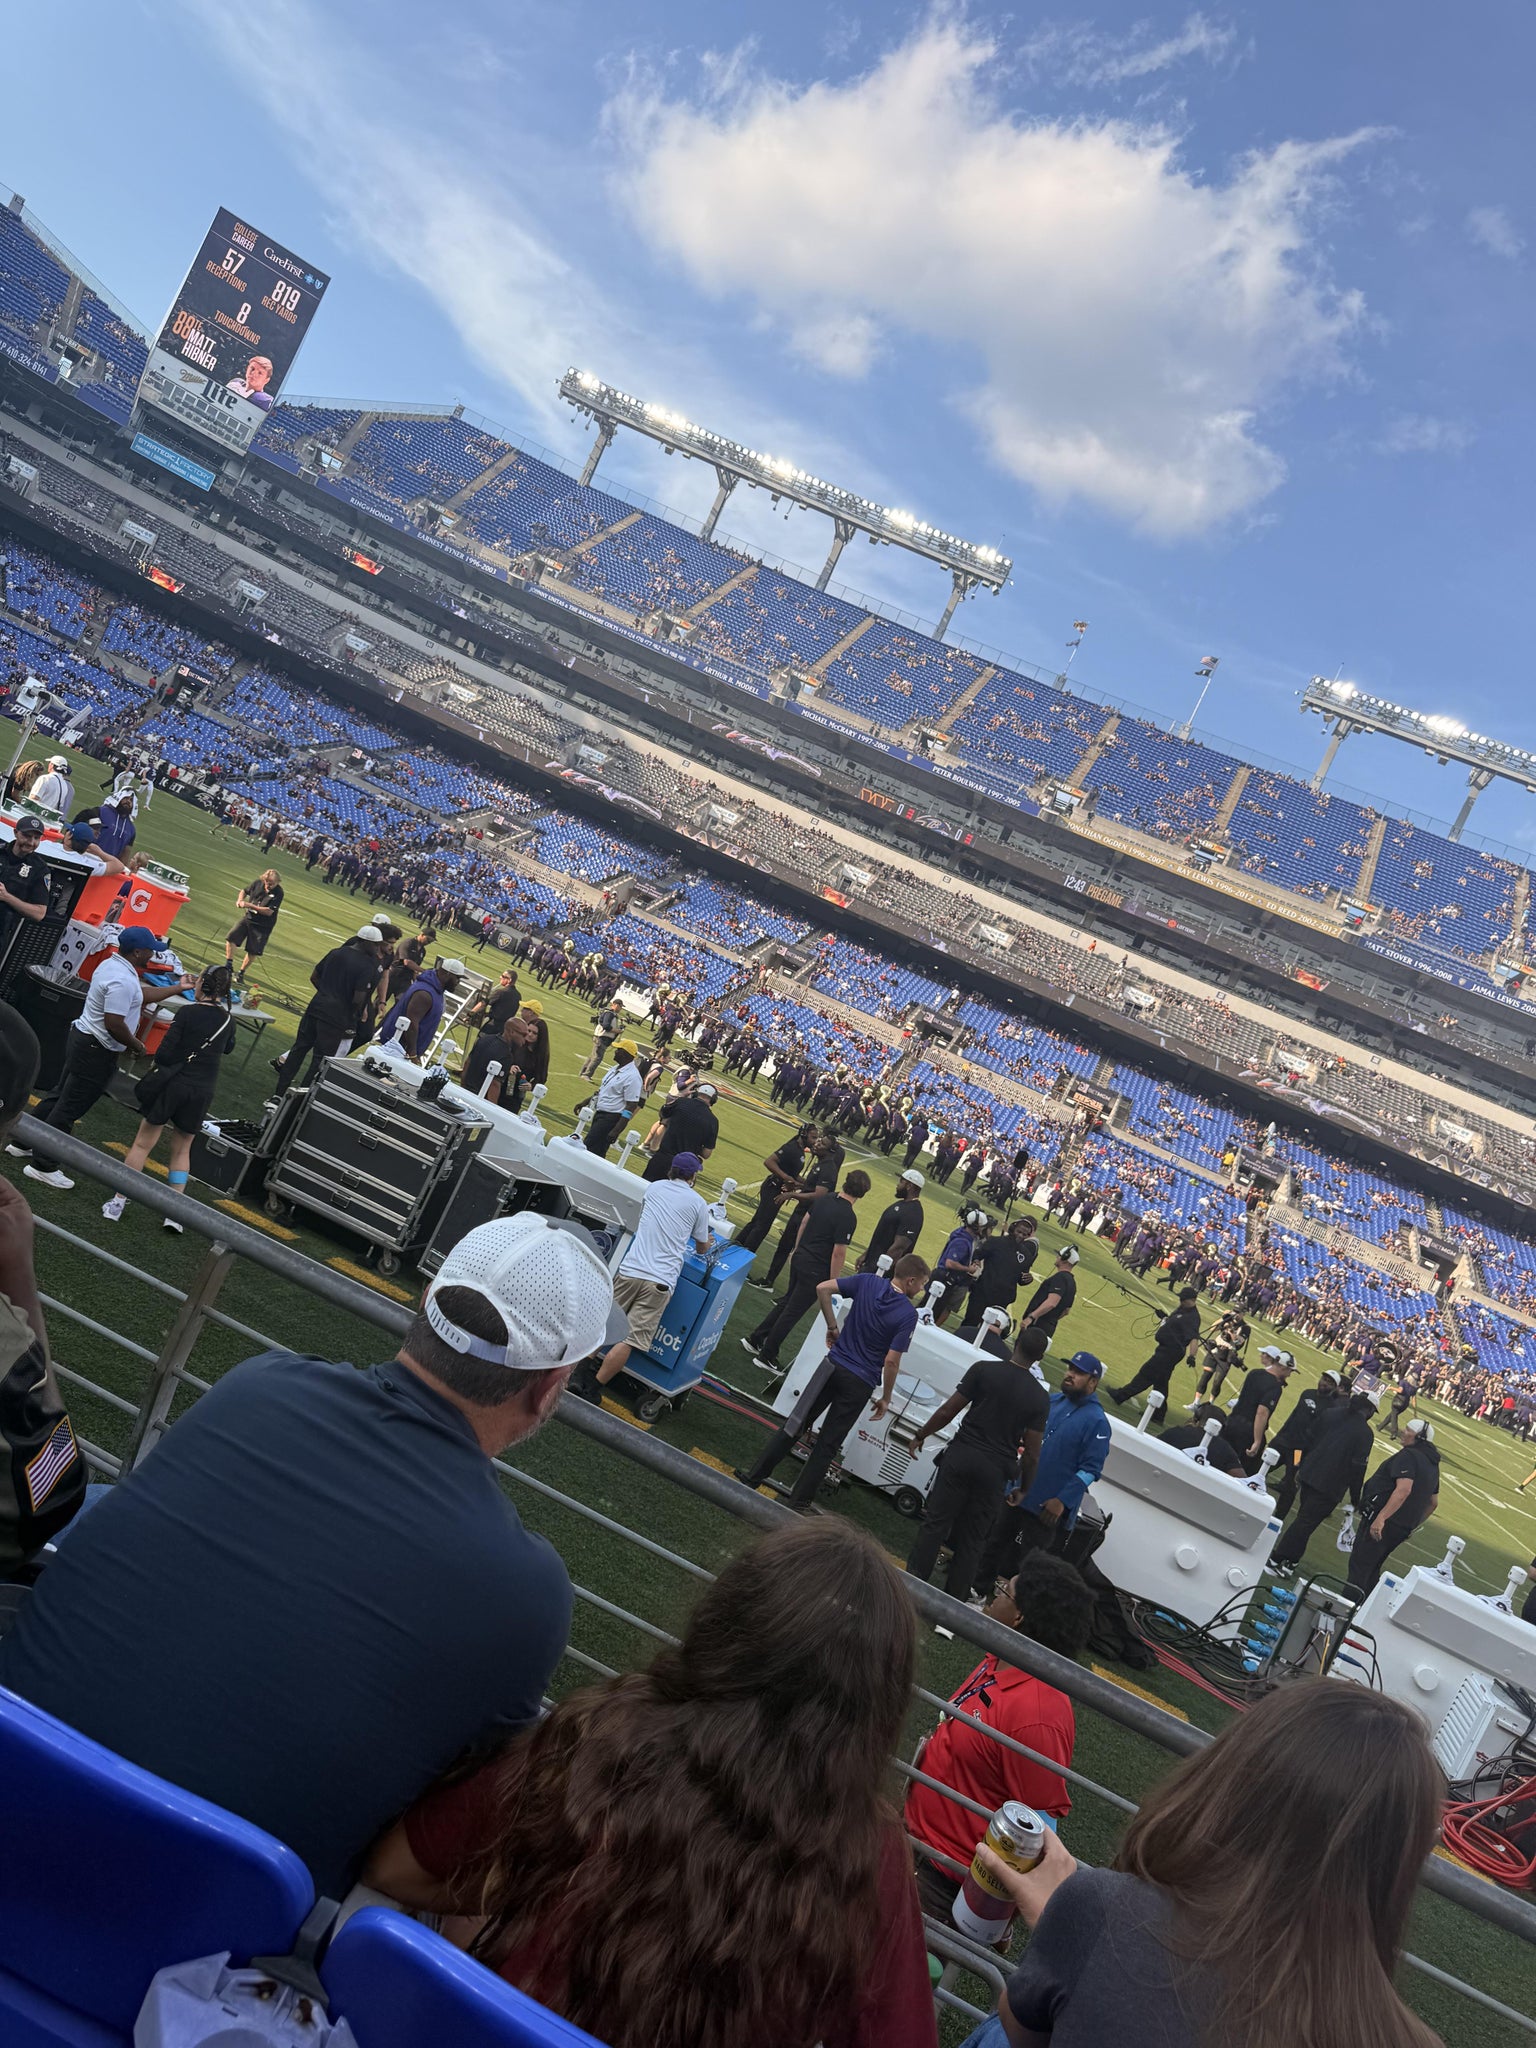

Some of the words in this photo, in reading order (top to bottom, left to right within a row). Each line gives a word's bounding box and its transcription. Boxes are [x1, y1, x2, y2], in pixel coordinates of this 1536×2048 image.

[231, 232, 254, 251] CAREER
[234, 222, 258, 244] COLLEGE
[206, 260, 248, 292] RECEPTIONS
[222, 248, 246, 275] 57
[264, 247, 304, 280] CareFirst
[261, 296, 276, 312] REC
[275, 302, 298, 324] YARDS
[271, 280, 301, 311] 819
[172, 311, 194, 340] 88
[215, 309, 261, 345] TOUCHDOWNS
[237, 302, 252, 325] 8
[188, 328, 217, 354] MATT
[4, 346, 48, 375] 410-324-6141
[181, 343, 217, 372] HIBNER
[180, 368, 207, 385] Miller
[201, 380, 238, 410] Lite
[137, 436, 176, 461] STRATEGIC
[179, 460, 210, 480] FACTORY
[348, 496, 367, 509] RING
[368, 506, 395, 524] HONOR
[416, 531, 444, 549] EARNEST
[443, 545, 465, 559] BYNER
[465, 555, 497, 575] 1996-2003
[187, 670, 210, 686] BETMGM
[702, 665, 728, 680] ARTHUR
[734, 679, 760, 695] MODELL
[800, 708, 829, 725] MICHAEL
[827, 720, 857, 738] McCRARY
[856, 733, 890, 752] 1997-2002
[932, 765, 952, 778] PETER
[951, 773, 987, 793] BOULWARE
[986, 788, 1021, 808] 1997-2005
[673, 819, 775, 874] RAVENS
[1065, 820, 1102, 841] JONATHAN
[1102, 835, 1127, 851] OGDEN
[1128, 846, 1165, 866] 1996-2007
[1062, 874, 1086, 892] 12:43
[1085, 883, 1124, 908] PREGAME
[1176, 865, 1192, 876] RAY
[1191, 871, 1214, 885] LEWIS
[1215, 881, 1254, 901] 1996-2012
[130, 889, 152, 913] G
[1265, 901, 1277, 910] ED
[1277, 905, 1297, 918] REED
[1296, 913, 1338, 935] 2002-2012
[1363, 940, 1385, 954] MATT
[1384, 948, 1413, 965] STOVER
[1412, 959, 1453, 981] 1996-2008
[1470, 984, 1496, 999] JAMAL
[1496, 994, 1520, 1008] LEWIS
[1520, 1003, 1536, 1016] 200
[932, 1017, 954, 1031] BETMGM
[1405, 1141, 1536, 1207] RAVENS
[1429, 1241, 1457, 1257] BETMGM
